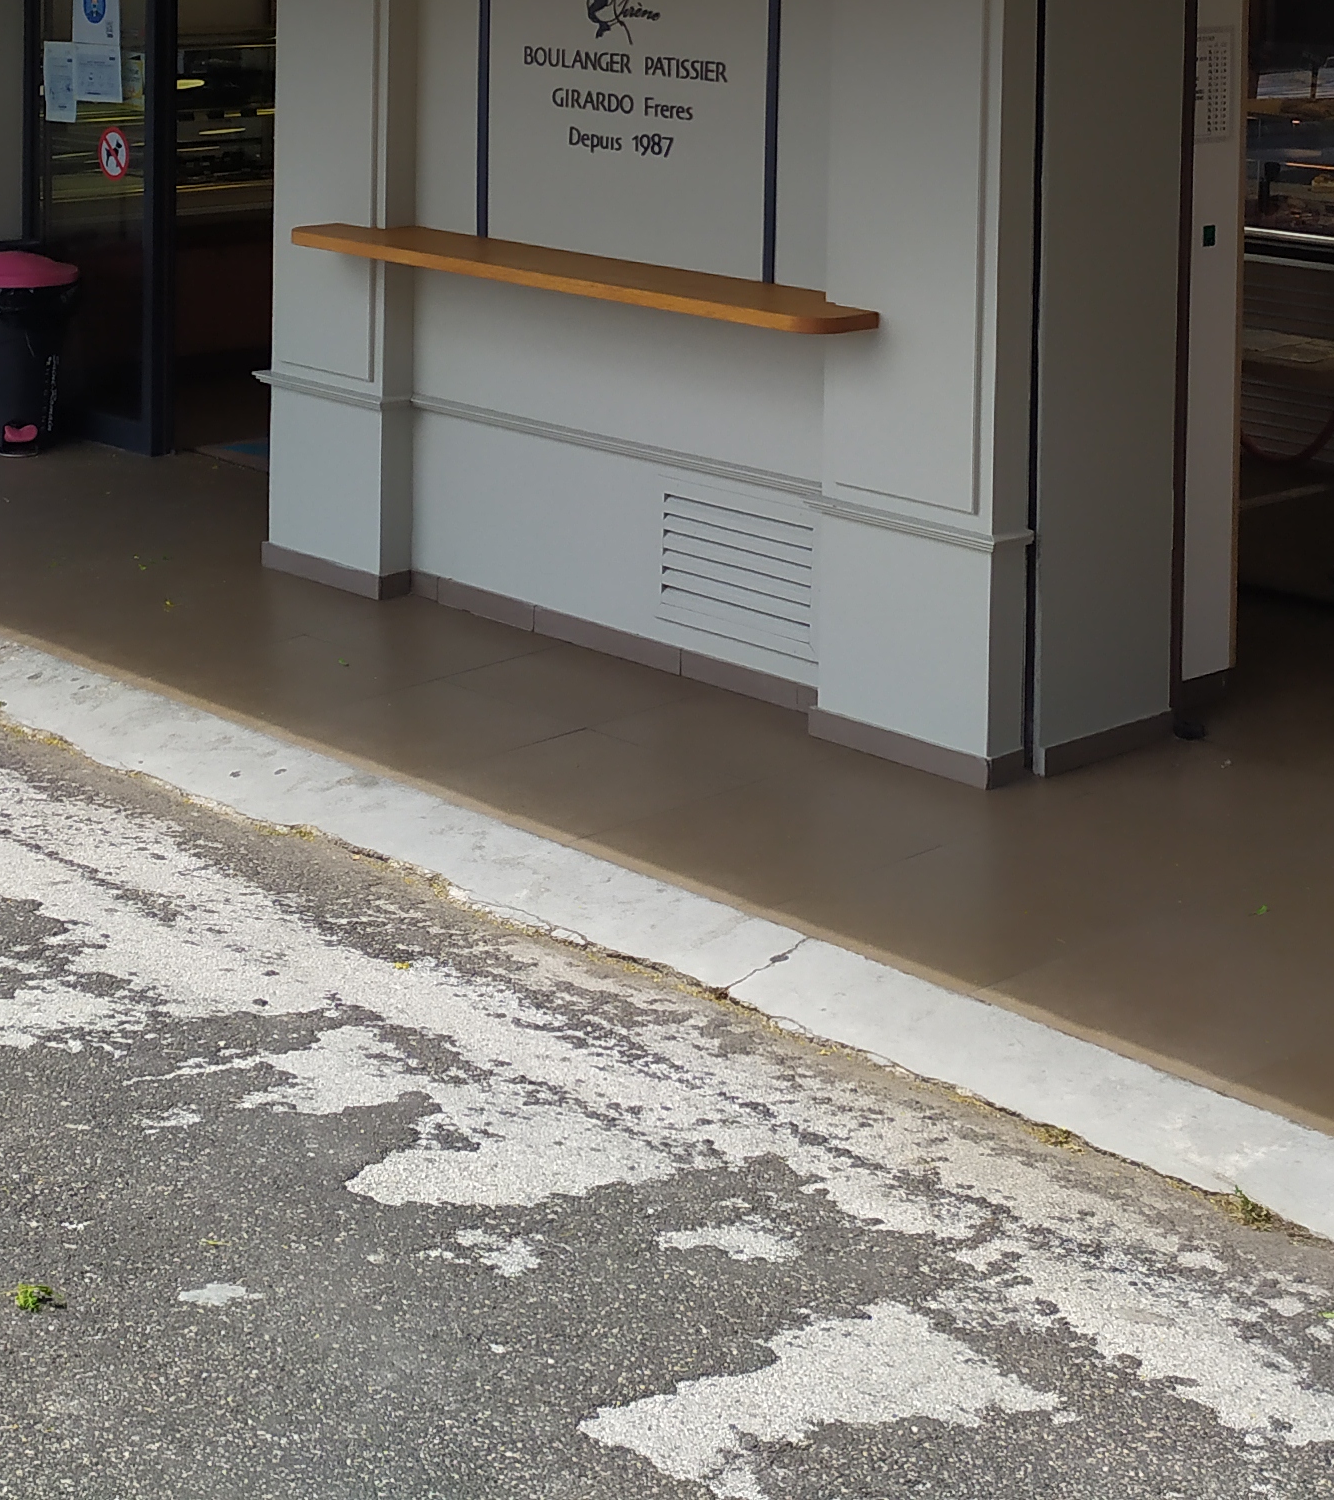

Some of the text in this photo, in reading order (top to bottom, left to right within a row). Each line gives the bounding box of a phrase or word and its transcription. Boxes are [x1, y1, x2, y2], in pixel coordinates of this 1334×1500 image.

[523, 45, 728, 83] BOULANGER PATISSIER
[552, 87, 693, 121] GIRARDO Freres
[568, 126, 674, 158] Depuis 1987
